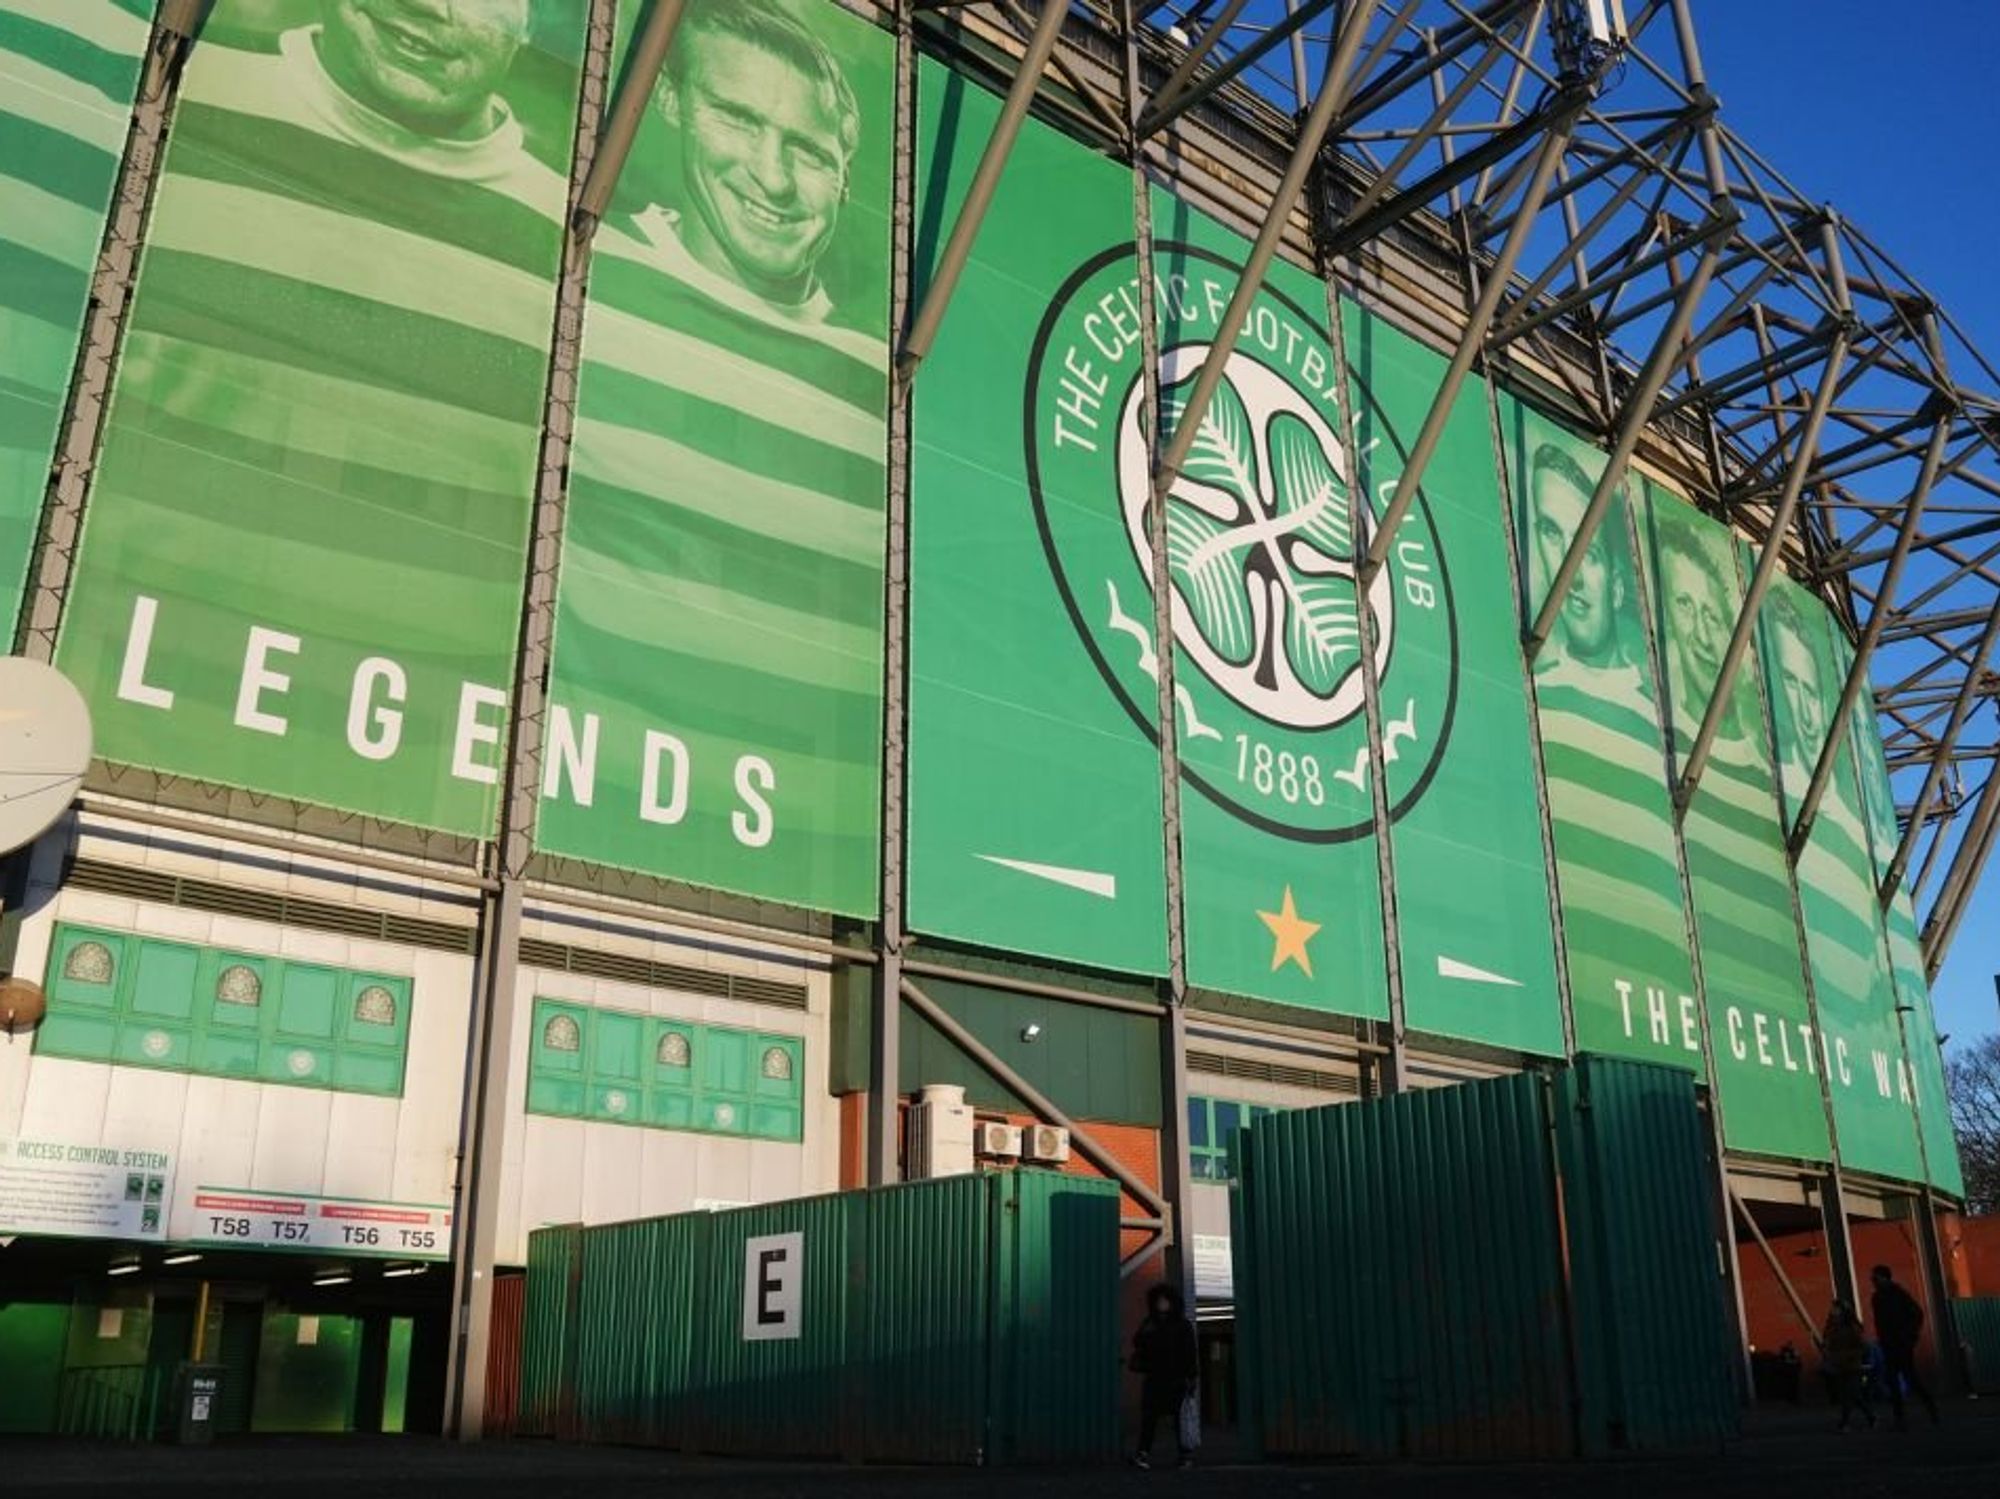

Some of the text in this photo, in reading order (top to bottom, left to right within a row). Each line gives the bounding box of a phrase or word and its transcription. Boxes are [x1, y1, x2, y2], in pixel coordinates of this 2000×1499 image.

[1055, 346, 1108, 452] THE
[1378, 479, 1436, 610] CUB
[116, 595, 776, 847] LEGENDS
[1235, 734, 1324, 806] 1888
[1615, 979, 1698, 1051] THE
[1726, 1006, 1851, 1086] CELTIC
[16, 1141, 65, 1161] ACCESS
[67, 1145, 119, 1166] CONTROL
[122, 1151, 168, 1168] SYSTEM
[210, 1217, 435, 1248] T58 T57 T56 T55
[758, 1248, 786, 1325] E
